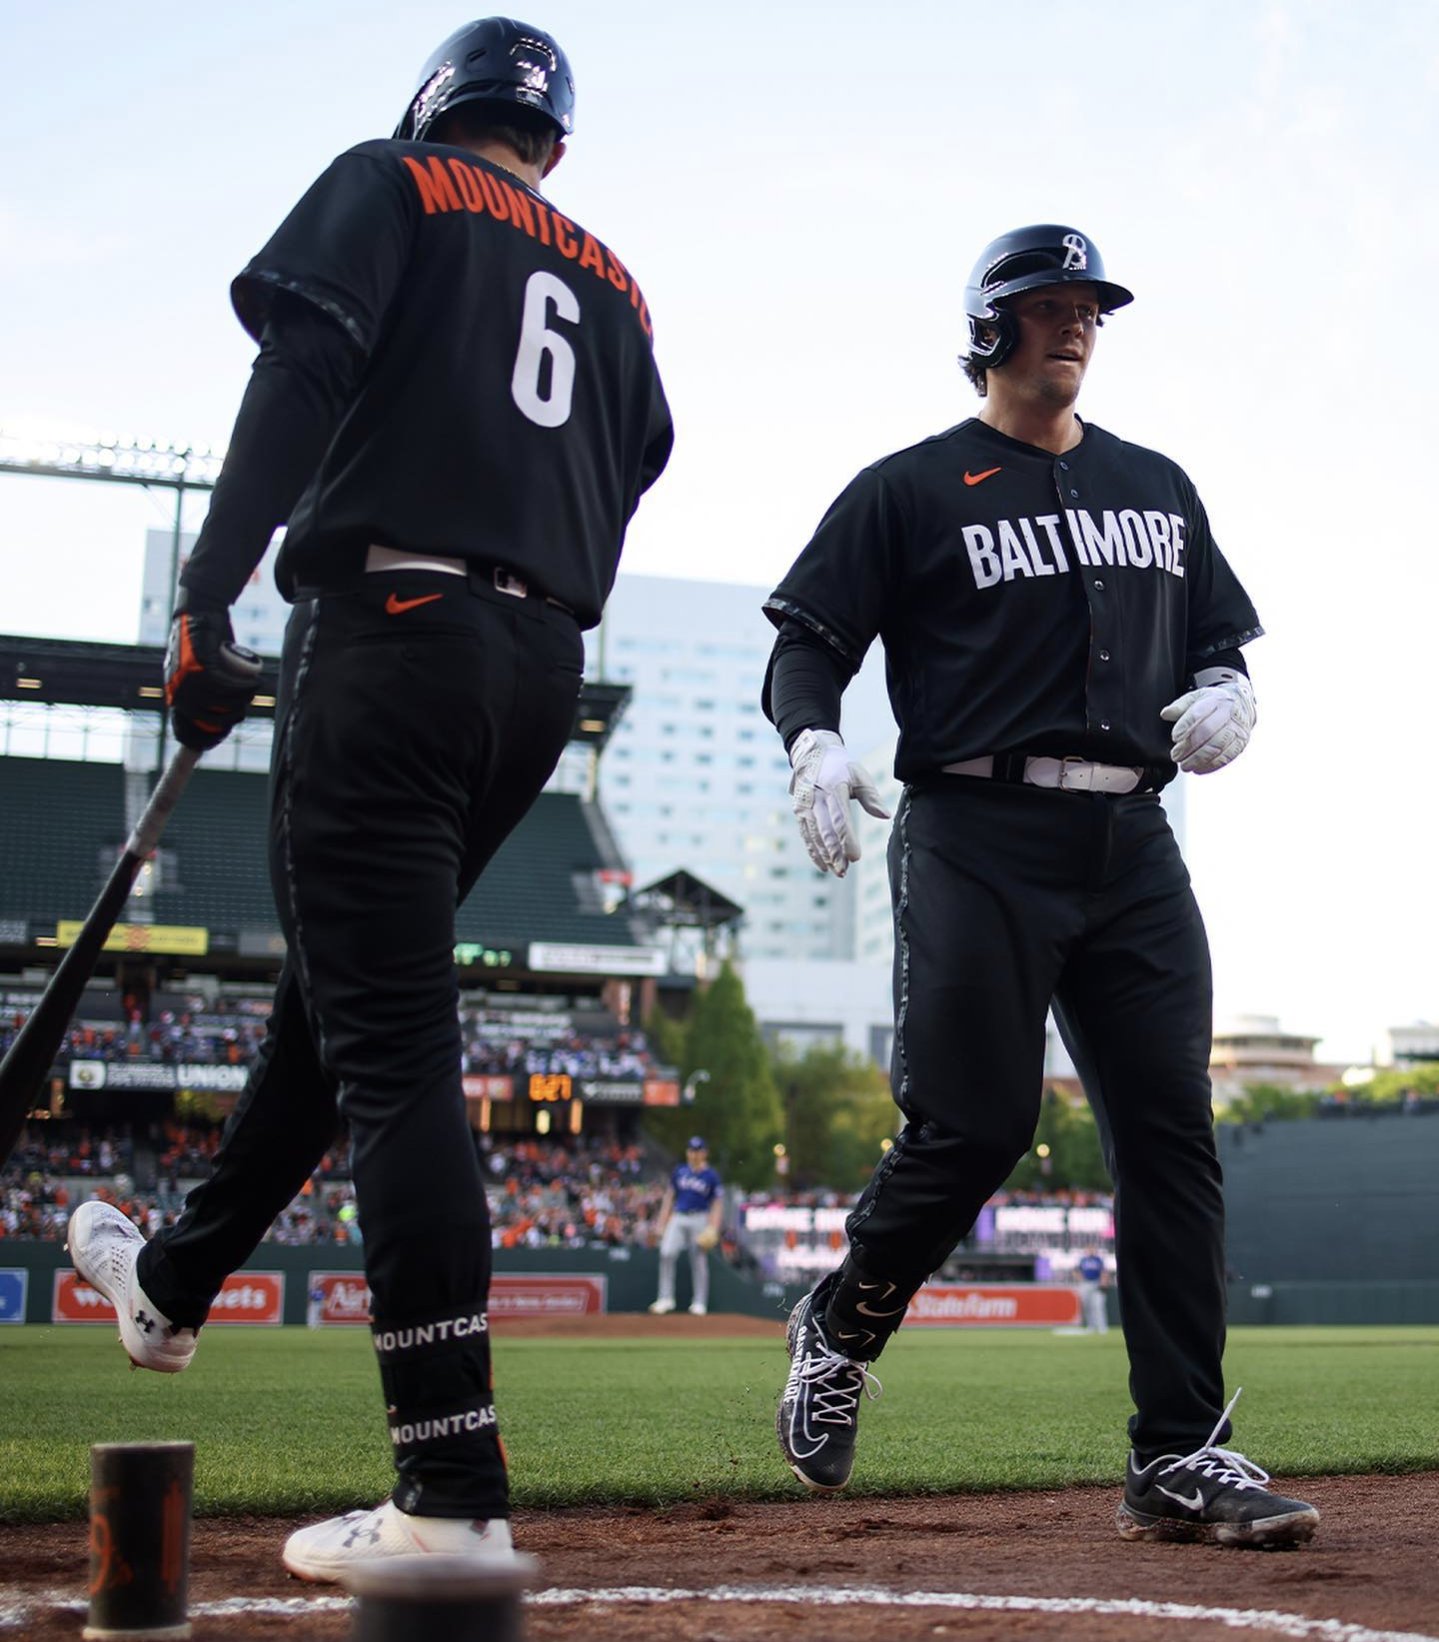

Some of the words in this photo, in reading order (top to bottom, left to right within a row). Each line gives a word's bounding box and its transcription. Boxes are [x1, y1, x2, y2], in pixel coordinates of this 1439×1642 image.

[511, 271, 580, 428] 6
[961, 509, 1185, 590] BALTIMORE
[177, 1064, 249, 1091] UNION
